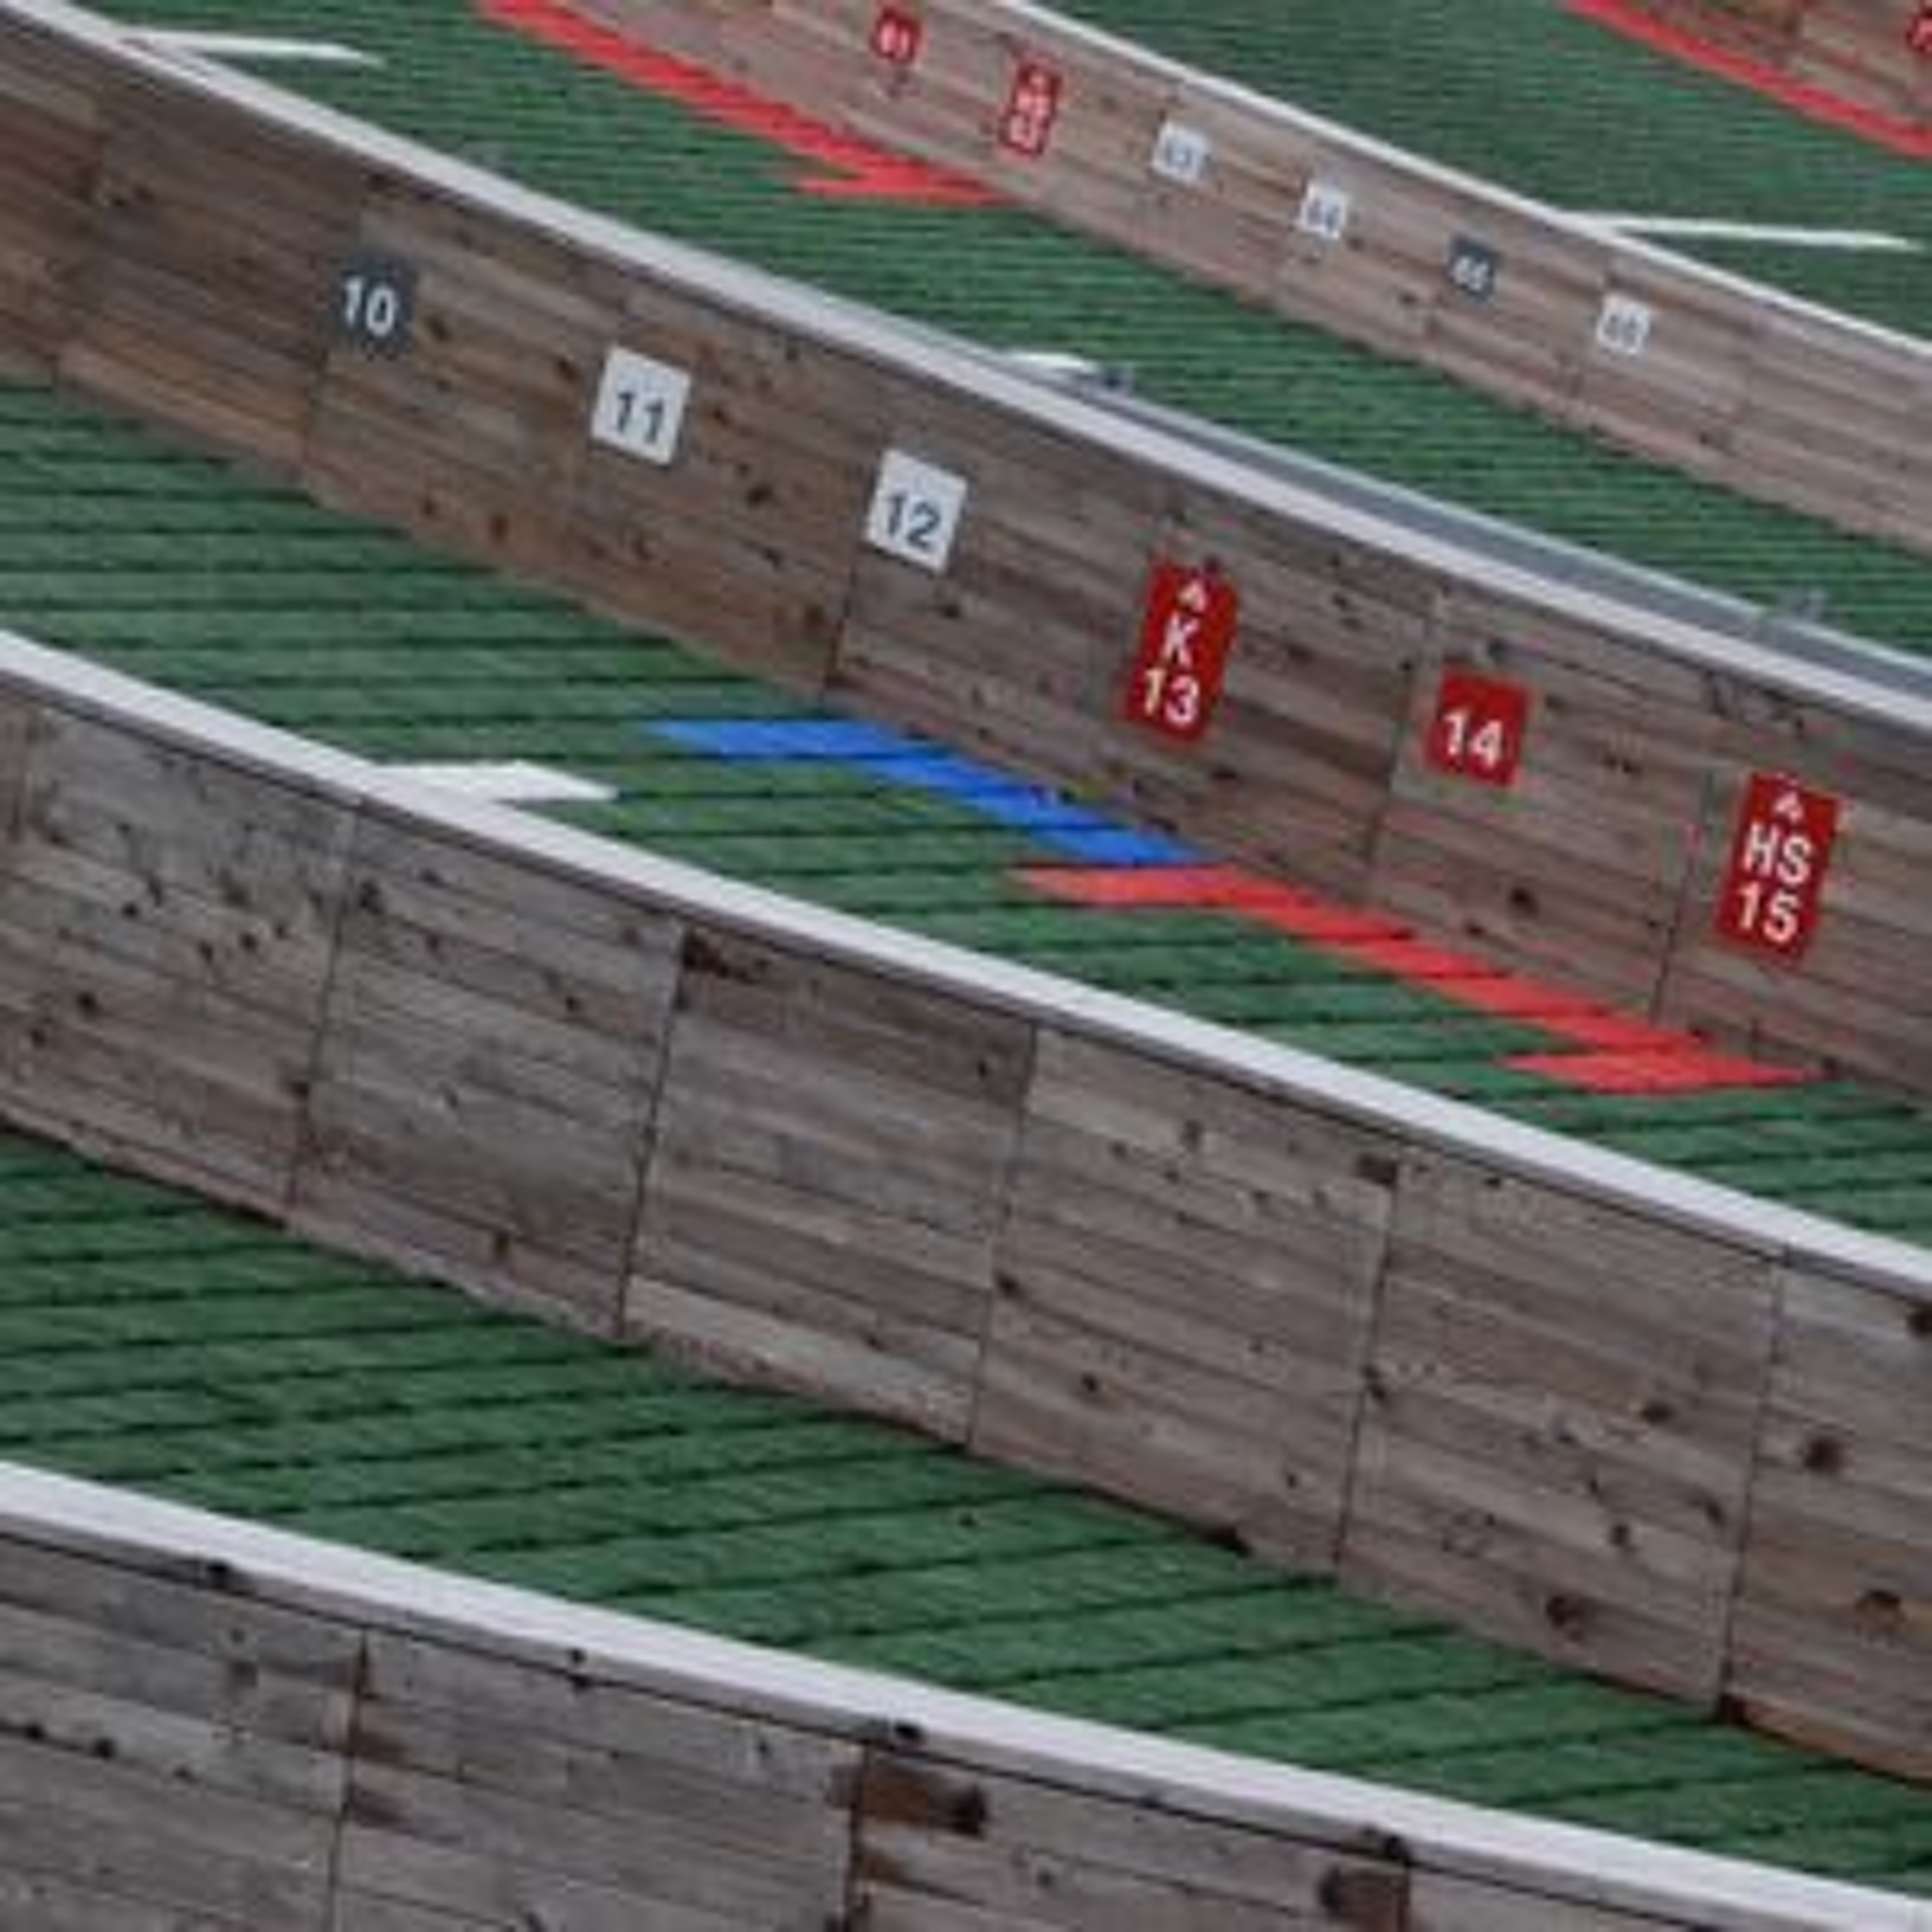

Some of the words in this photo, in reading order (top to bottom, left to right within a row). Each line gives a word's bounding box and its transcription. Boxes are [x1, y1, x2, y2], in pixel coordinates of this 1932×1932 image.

[343, 276, 397, 337] 10
[616, 390, 667, 444] 11
[886, 493, 942, 549] 12
[1162, 612, 1200, 668] K
[1145, 668, 1200, 728] 13
[1443, 710, 1502, 768] 14
[1743, 822, 1812, 886] HS
[1738, 882, 1799, 944] 15
